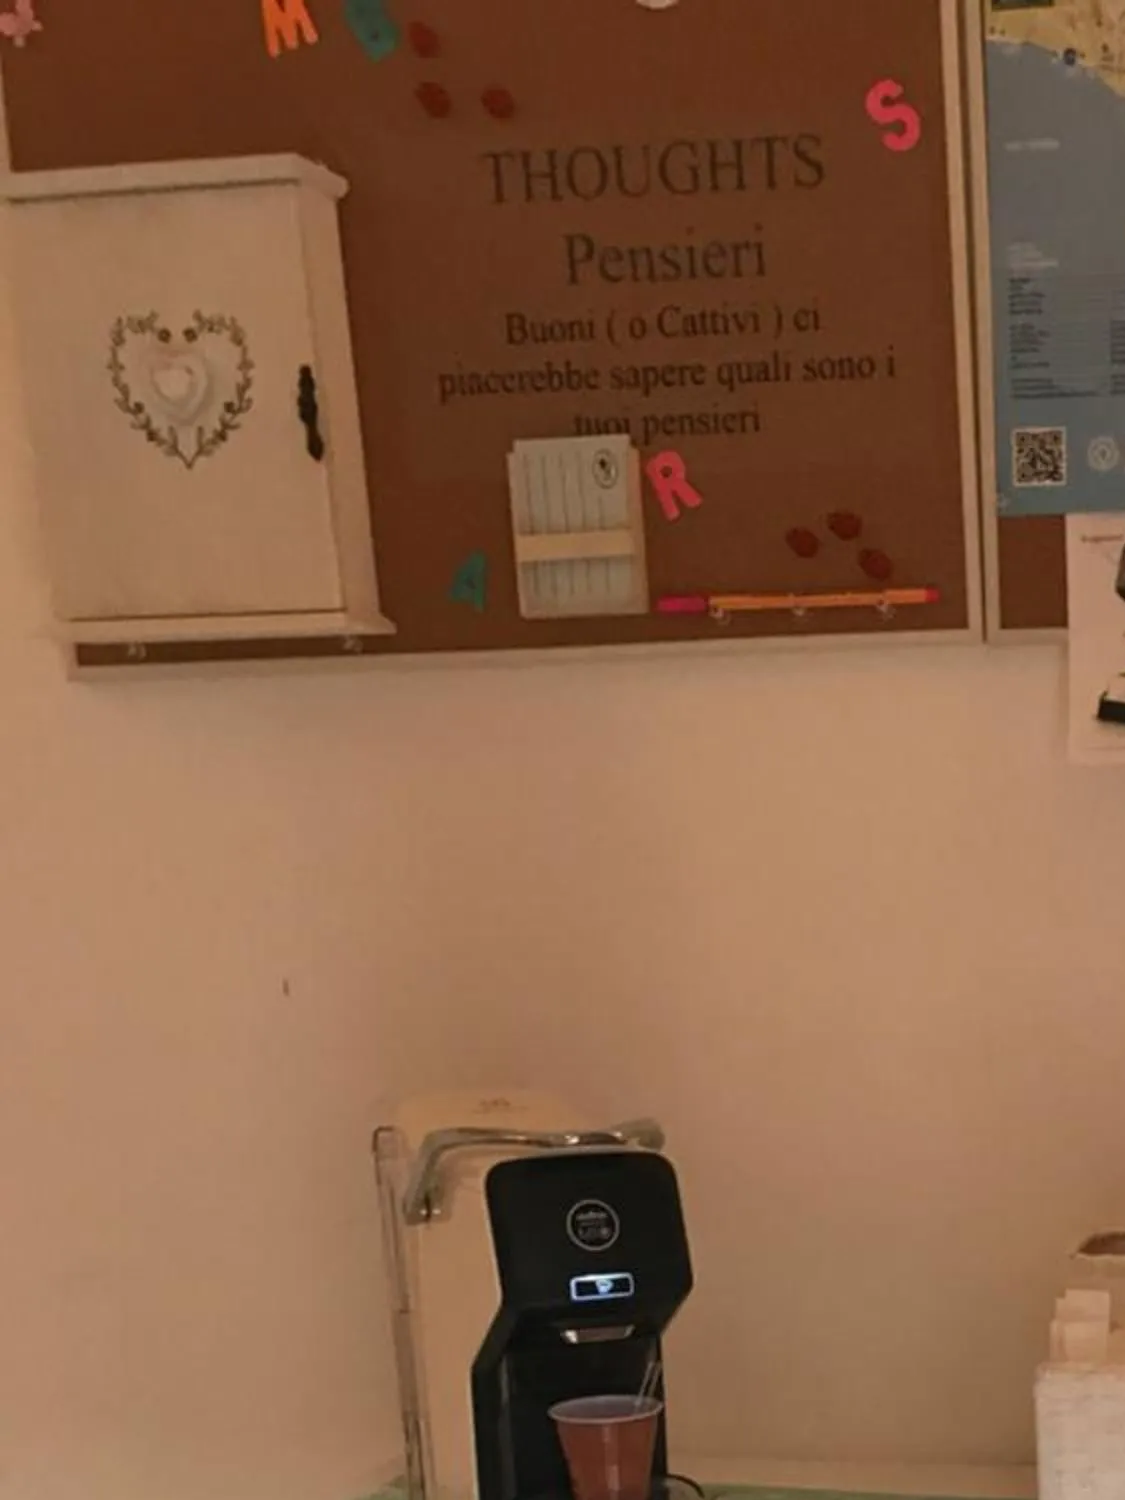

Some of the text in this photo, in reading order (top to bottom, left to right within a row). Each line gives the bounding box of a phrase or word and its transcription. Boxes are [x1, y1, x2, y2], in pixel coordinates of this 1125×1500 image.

[866, 79, 921, 151] S
[484, 134, 826, 205] THOUGHTS
[563, 224, 767, 286] Pensieri
[505, 311, 596, 346] Buoni
[628, 315, 647, 339] o
[656, 304, 761, 340] Cattivi
[793, 300, 821, 332] ci
[438, 345, 896, 402] piacerebbe sapere quali sono i
[642, 401, 761, 446] pensieri
[647, 451, 702, 522] R
